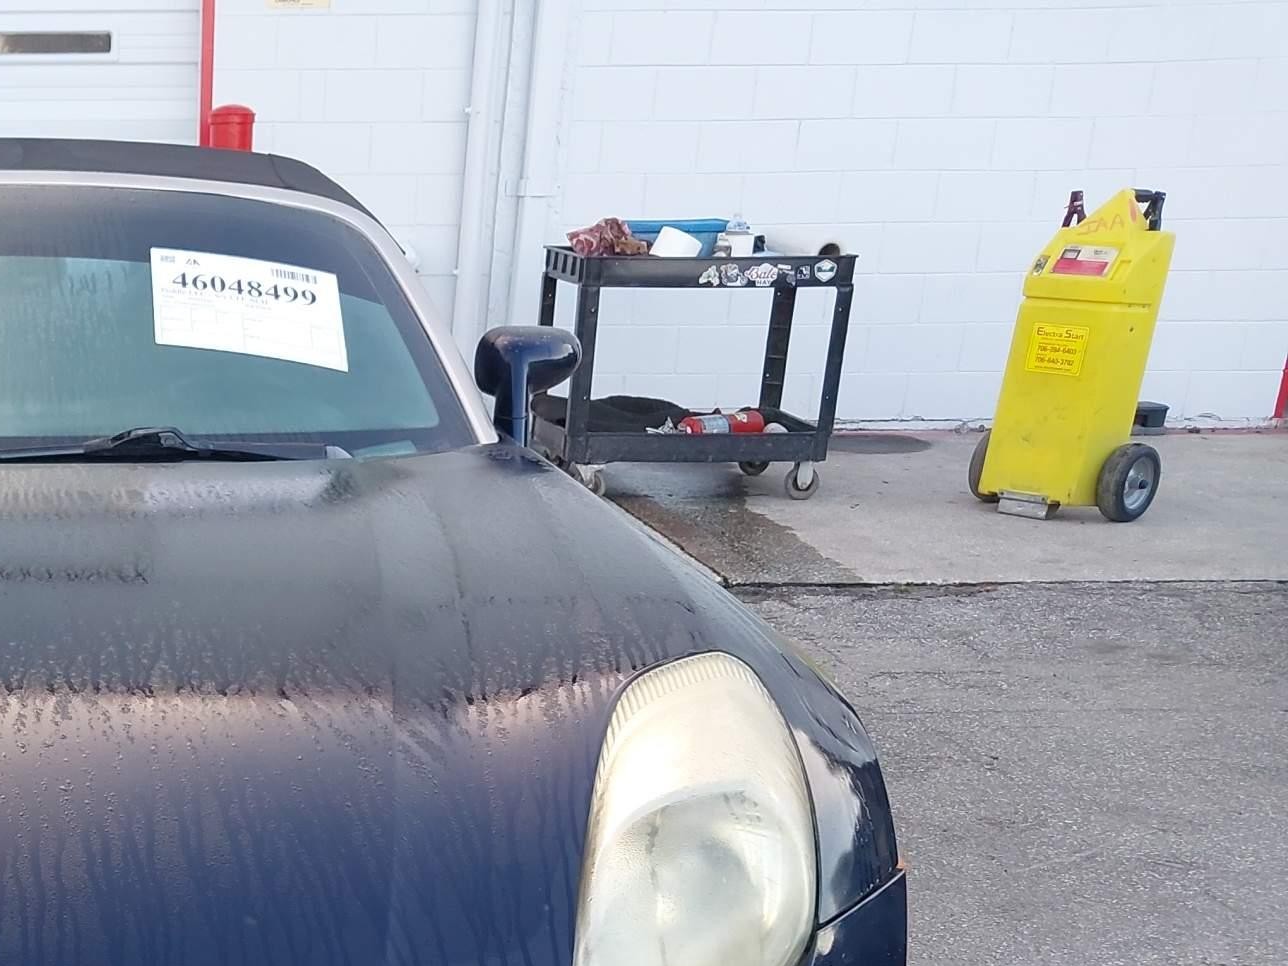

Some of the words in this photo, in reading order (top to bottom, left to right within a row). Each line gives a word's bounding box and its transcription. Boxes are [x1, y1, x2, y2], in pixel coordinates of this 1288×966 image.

[1076, 213, 1125, 236] IAA
[172, 272, 318, 306] 46048499
[1064, 329, 1084, 340] Start
